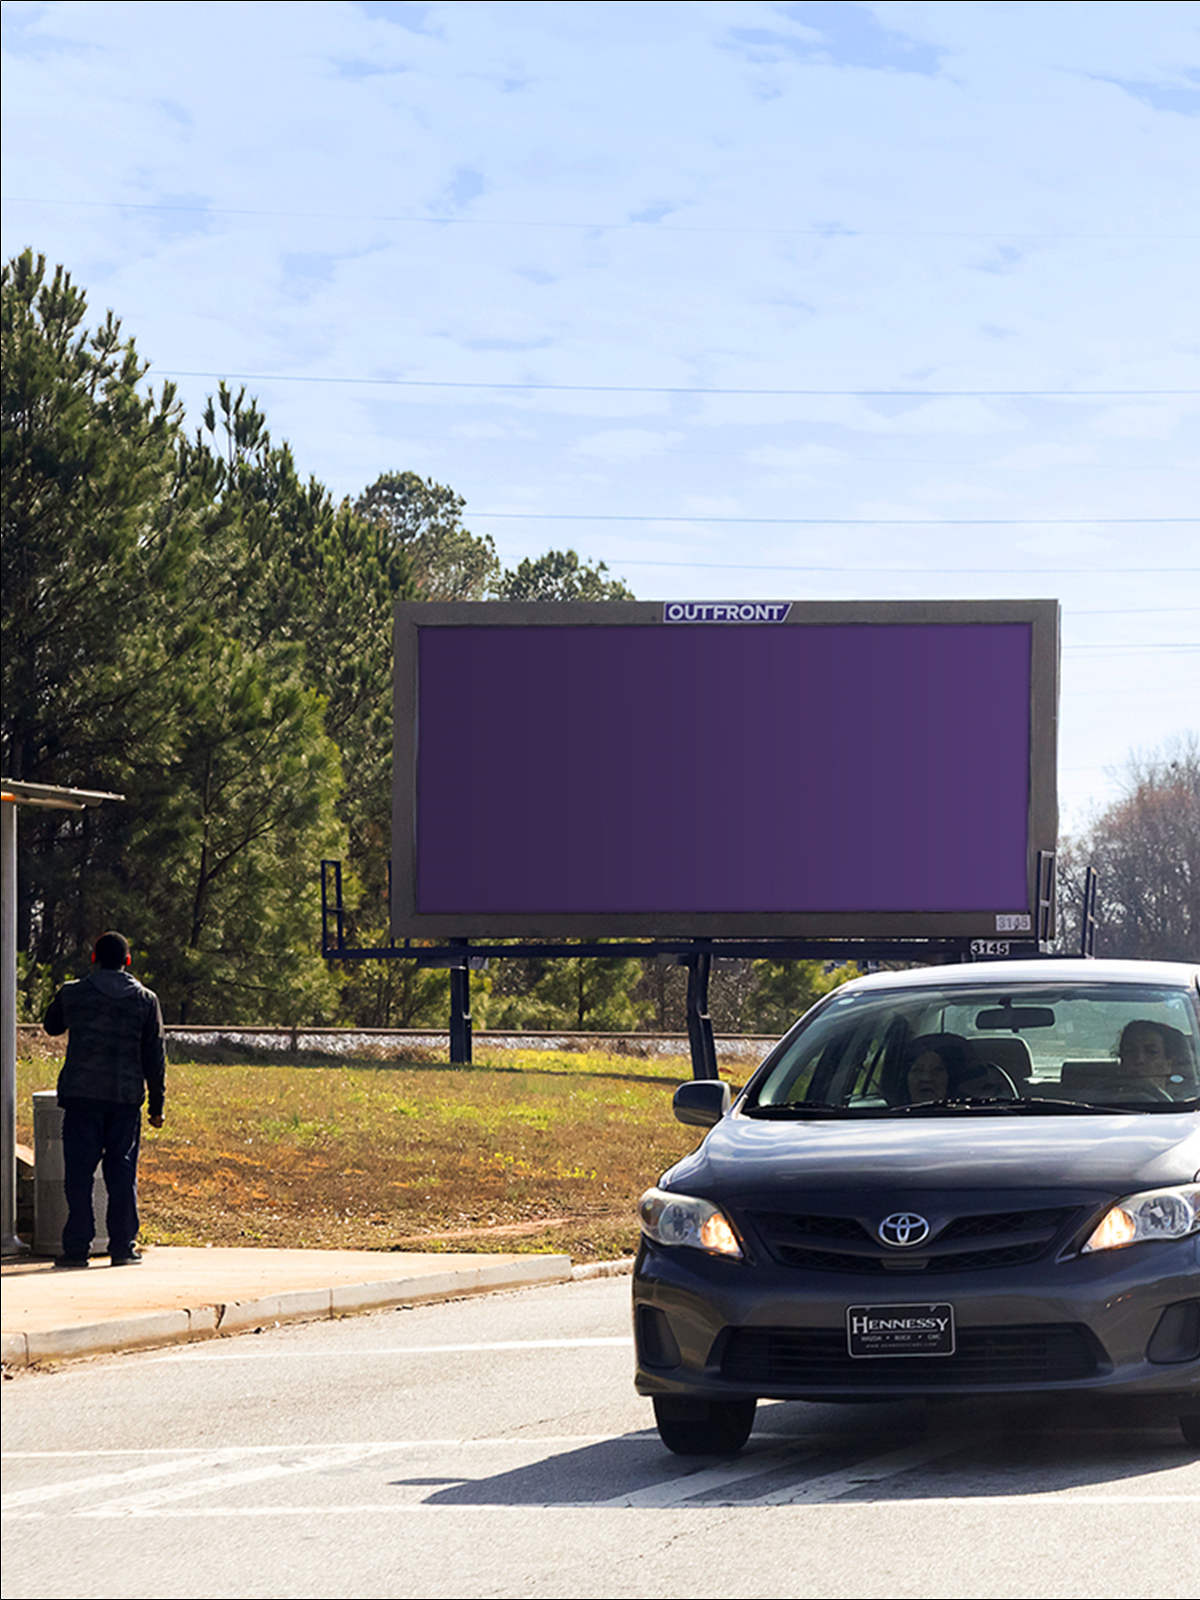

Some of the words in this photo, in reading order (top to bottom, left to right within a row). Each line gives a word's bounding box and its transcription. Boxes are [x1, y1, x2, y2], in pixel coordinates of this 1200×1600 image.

[668, 604, 784, 620] OUTFRONT
[971, 942, 1009, 954] 3145
[852, 1316, 949, 1334] HENNESSY
